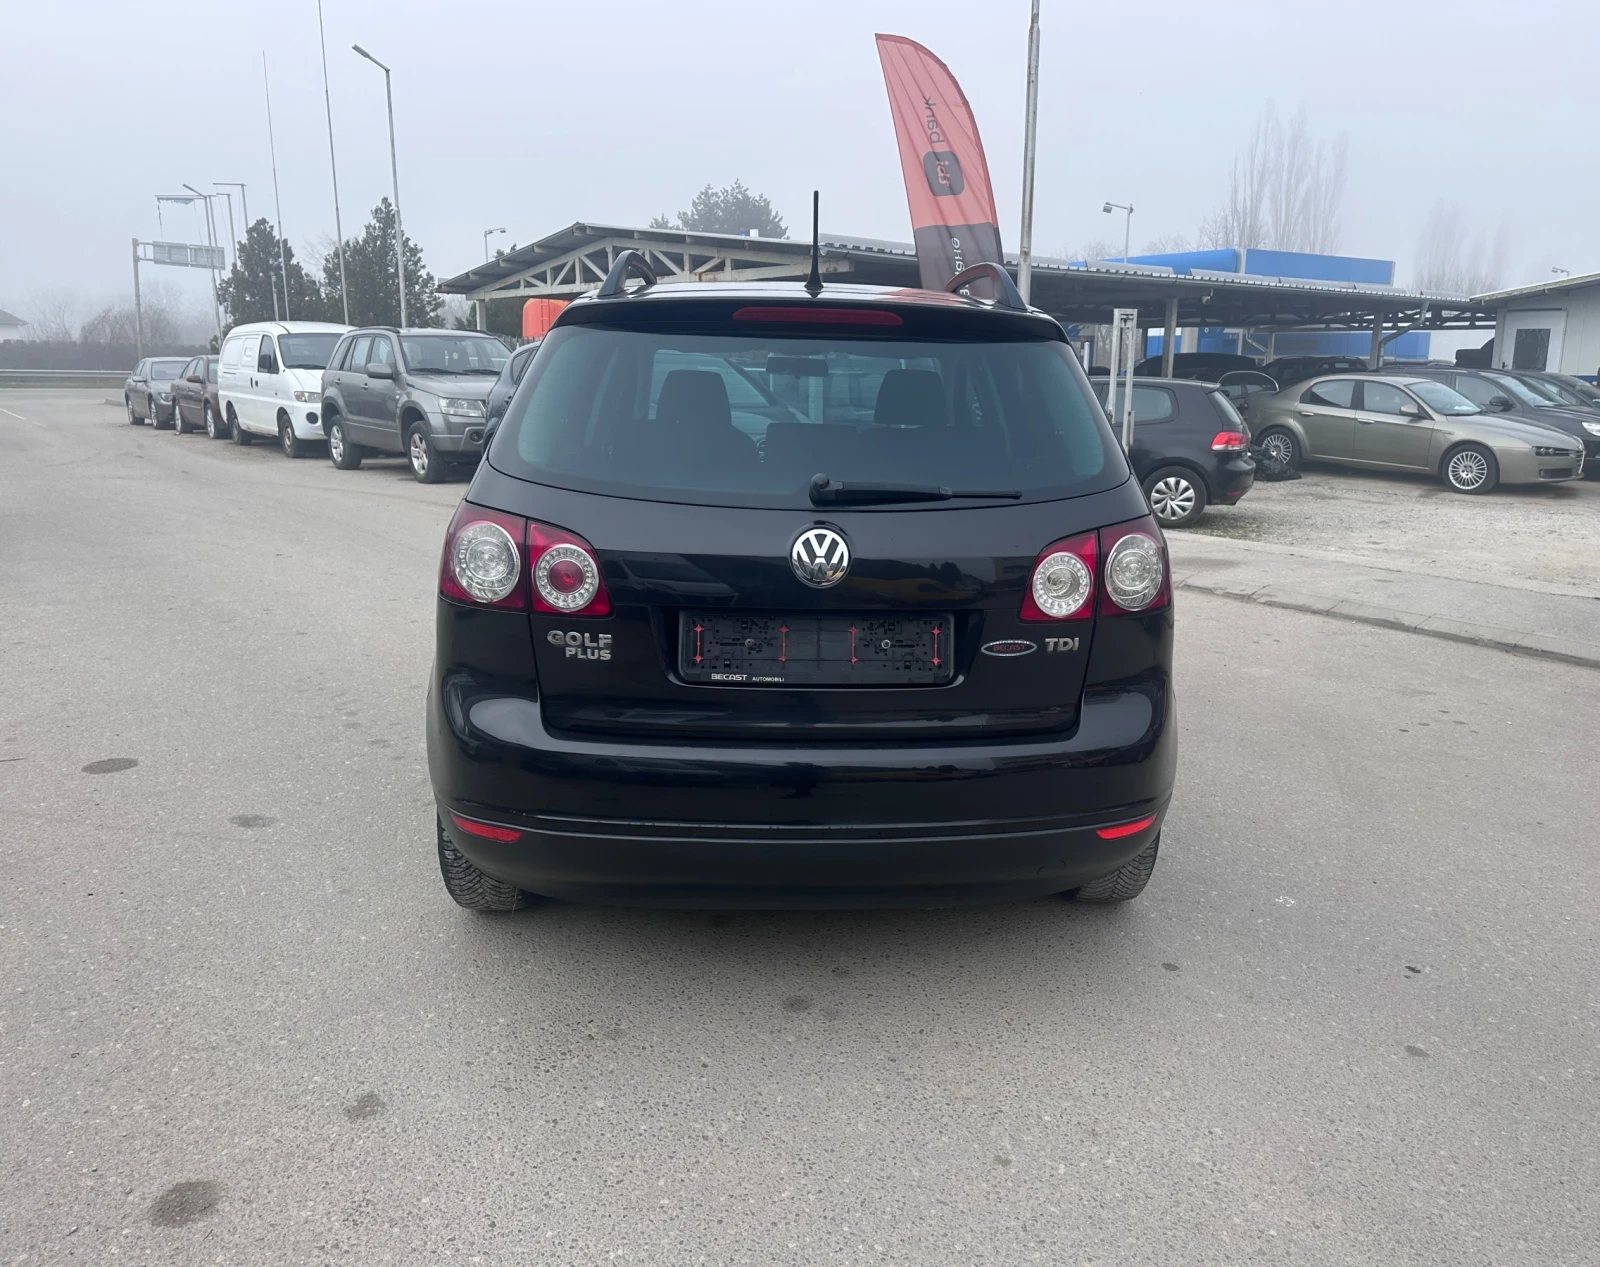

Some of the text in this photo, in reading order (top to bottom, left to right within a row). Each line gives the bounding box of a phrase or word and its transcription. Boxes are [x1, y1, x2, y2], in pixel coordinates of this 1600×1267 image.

[791, 527, 850, 588] VW
[546, 629, 613, 648] GOLF
[565, 646, 612, 661] PLUS
[992, 643, 1026, 653] BECAST
[710, 673, 748, 681] BECAST
